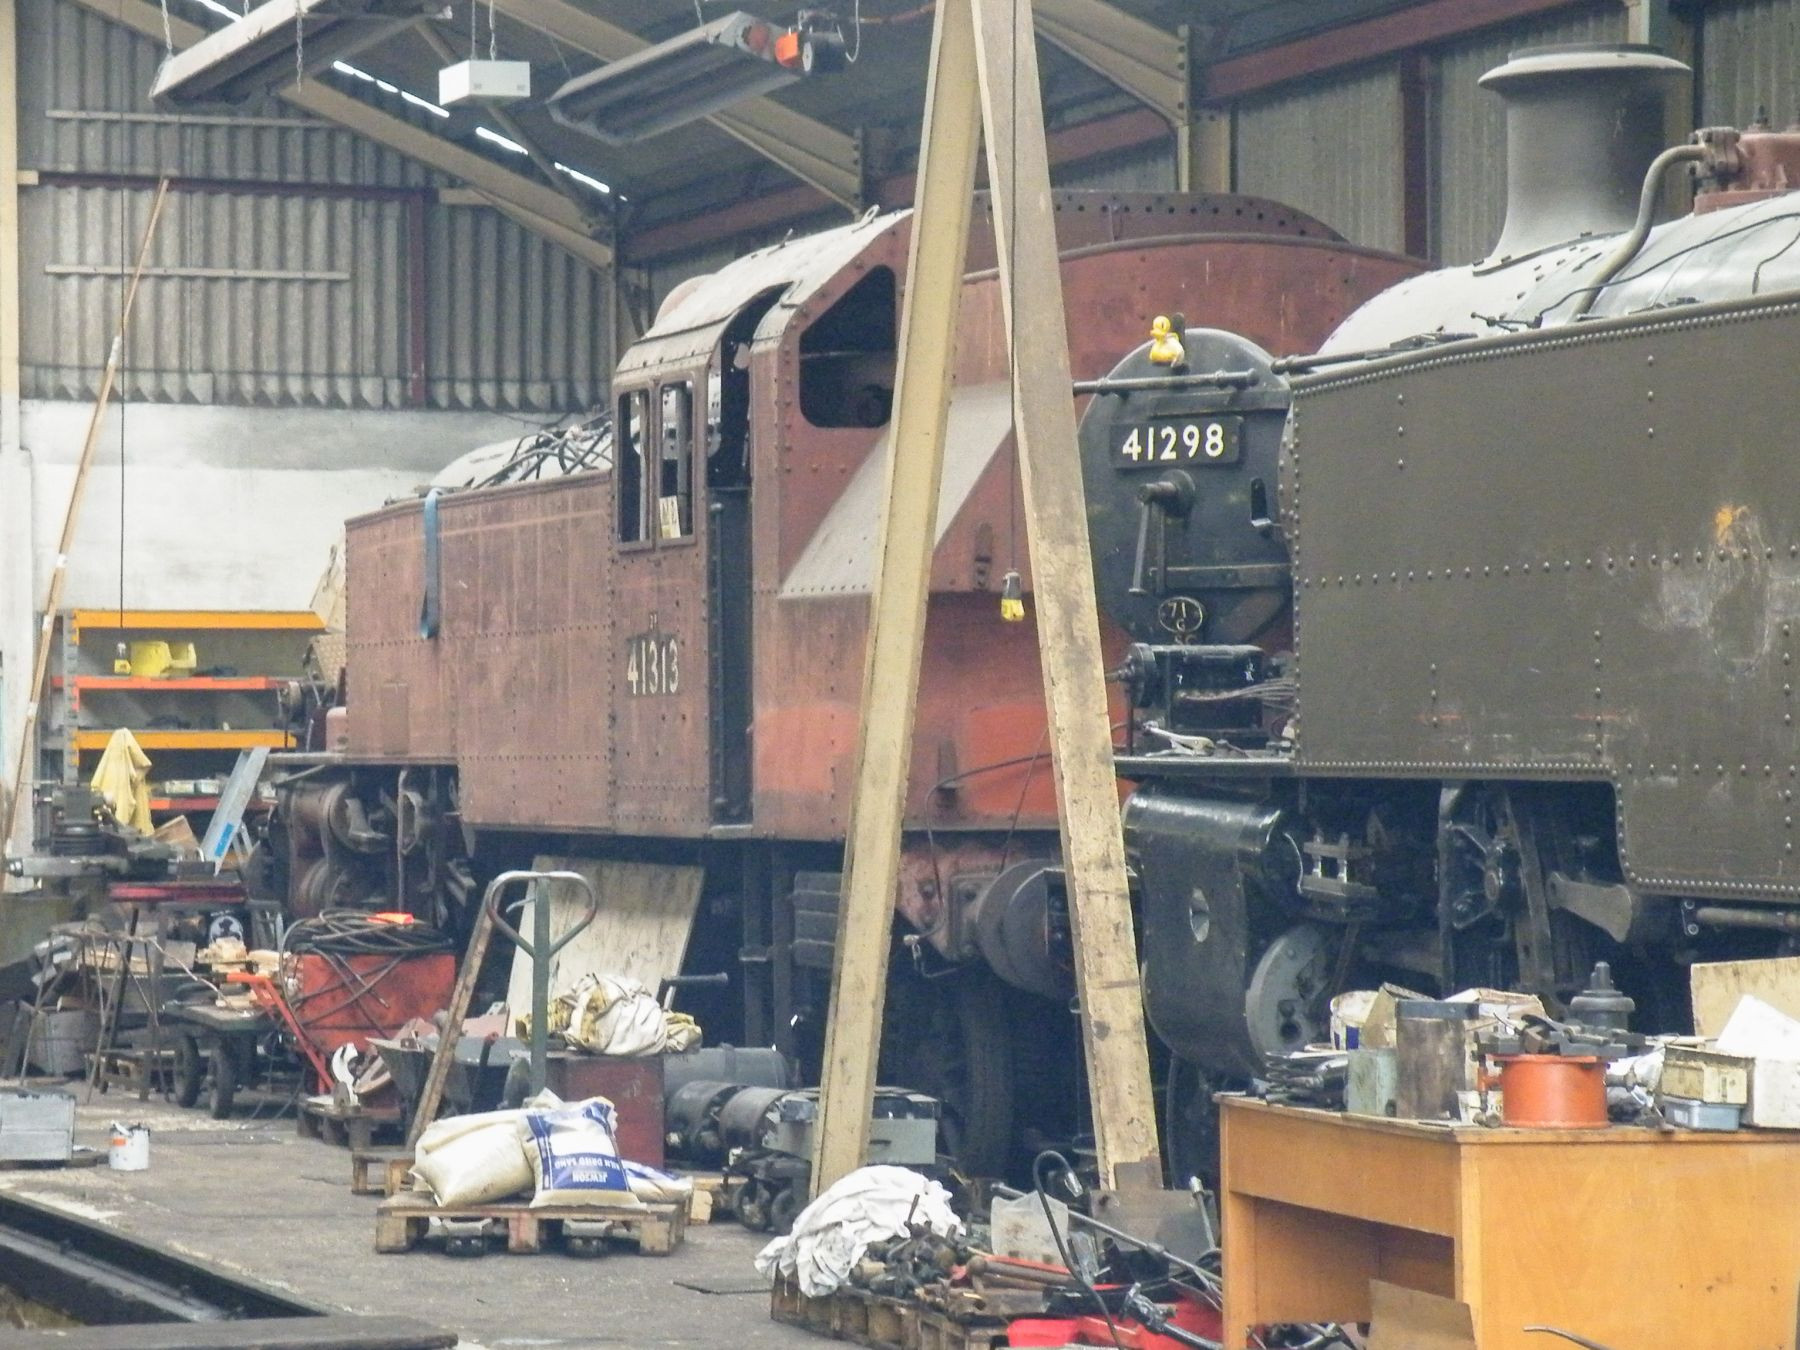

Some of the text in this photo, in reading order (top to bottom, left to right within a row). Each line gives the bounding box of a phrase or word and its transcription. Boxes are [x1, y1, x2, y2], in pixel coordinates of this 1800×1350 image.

[1122, 423, 1224, 461] 41298
[1167, 602, 1187, 618] 71
[627, 638, 679, 695] 41313
[554, 1157, 577, 1169] SAND
[578, 1157, 603, 1167] DRIED
[572, 1170, 608, 1183] JEWSON
